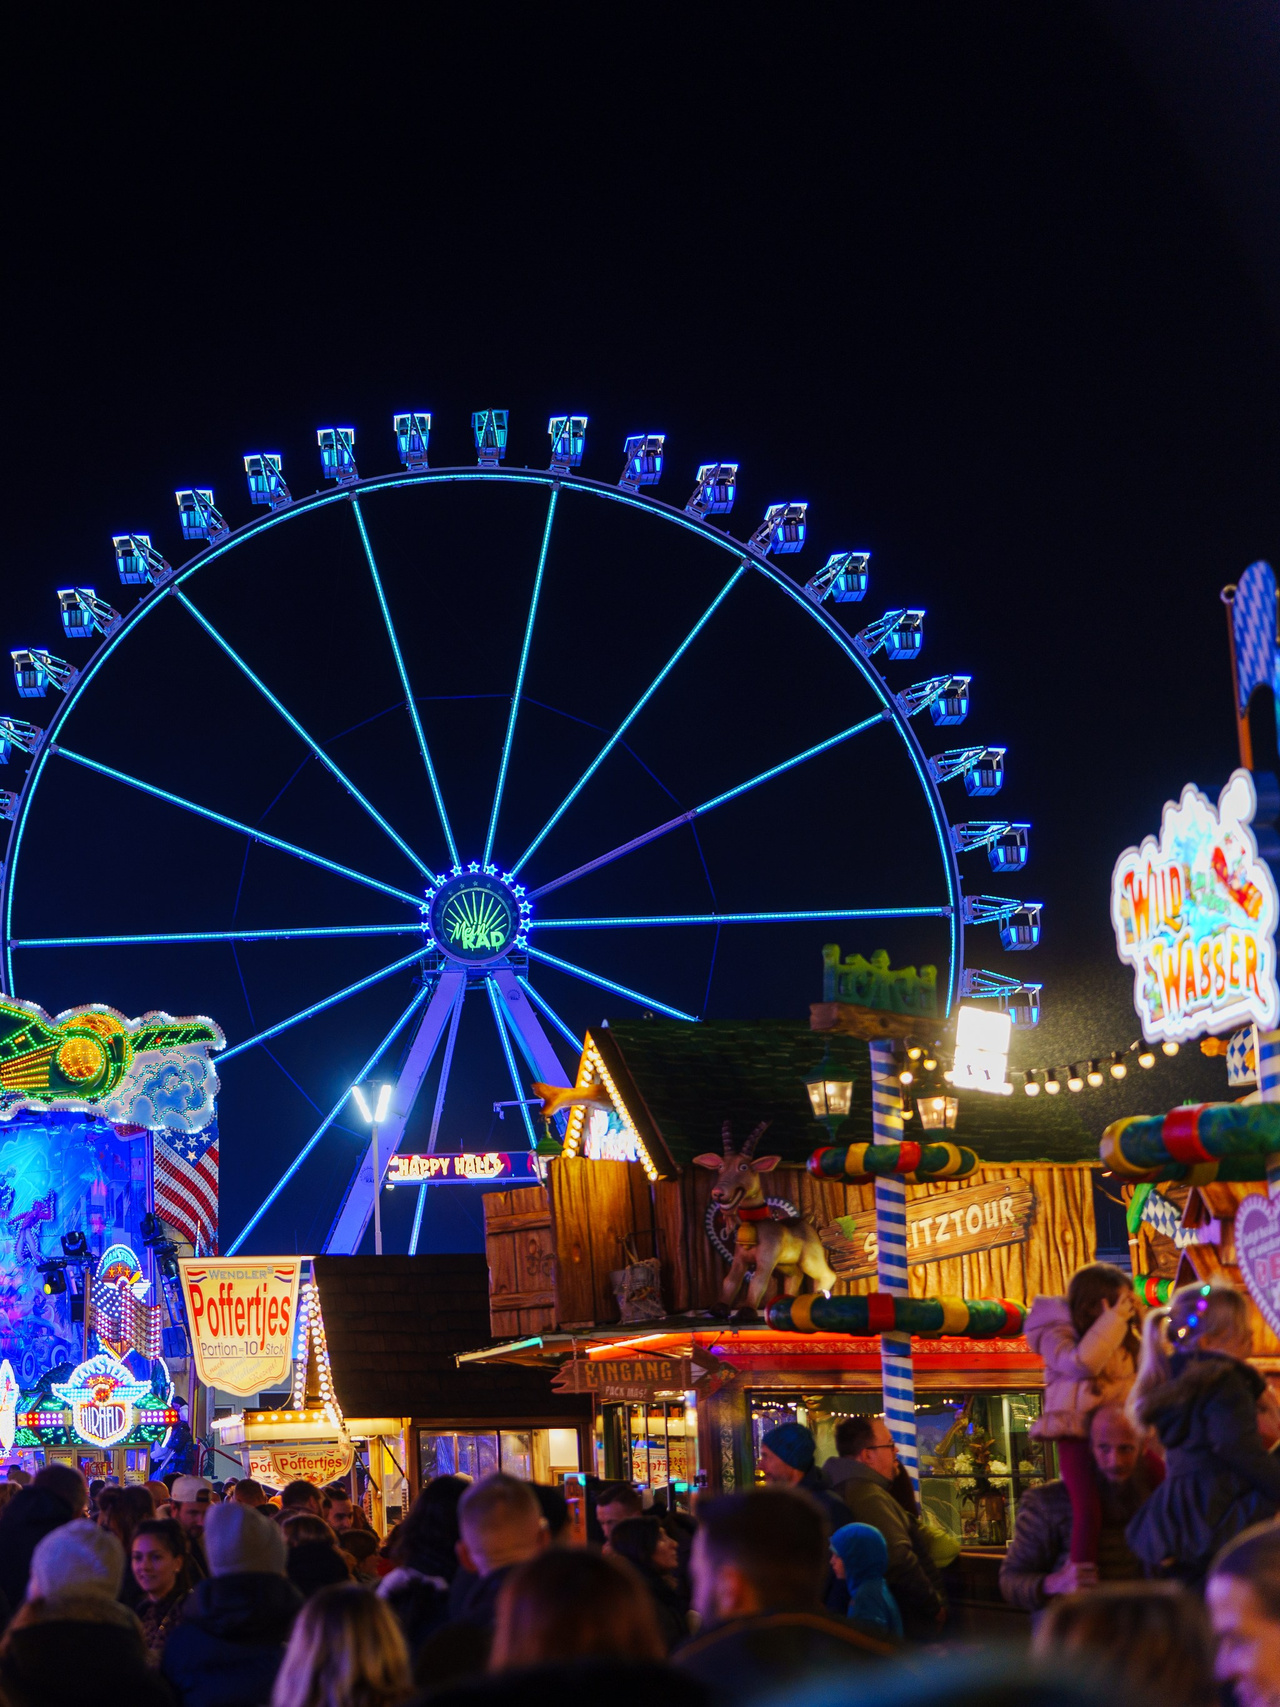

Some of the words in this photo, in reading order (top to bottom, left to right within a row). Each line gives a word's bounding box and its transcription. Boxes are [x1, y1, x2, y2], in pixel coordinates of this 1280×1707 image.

[1124, 860, 1186, 947] WILD
[450, 921, 490, 943] Mein
[463, 931, 505, 951] RAD
[1153, 931, 1266, 1020] WASSER
[398, 1157, 450, 1176] HAPPY
[863, 1196, 1016, 1262] SITZTOUR
[189, 1282, 291, 1351] Poffertjes
[71, 1358, 131, 1388] HANSTEIN
[584, 1361, 672, 1388] EINGANG
[280, 1456, 342, 1471] Poffertjes
